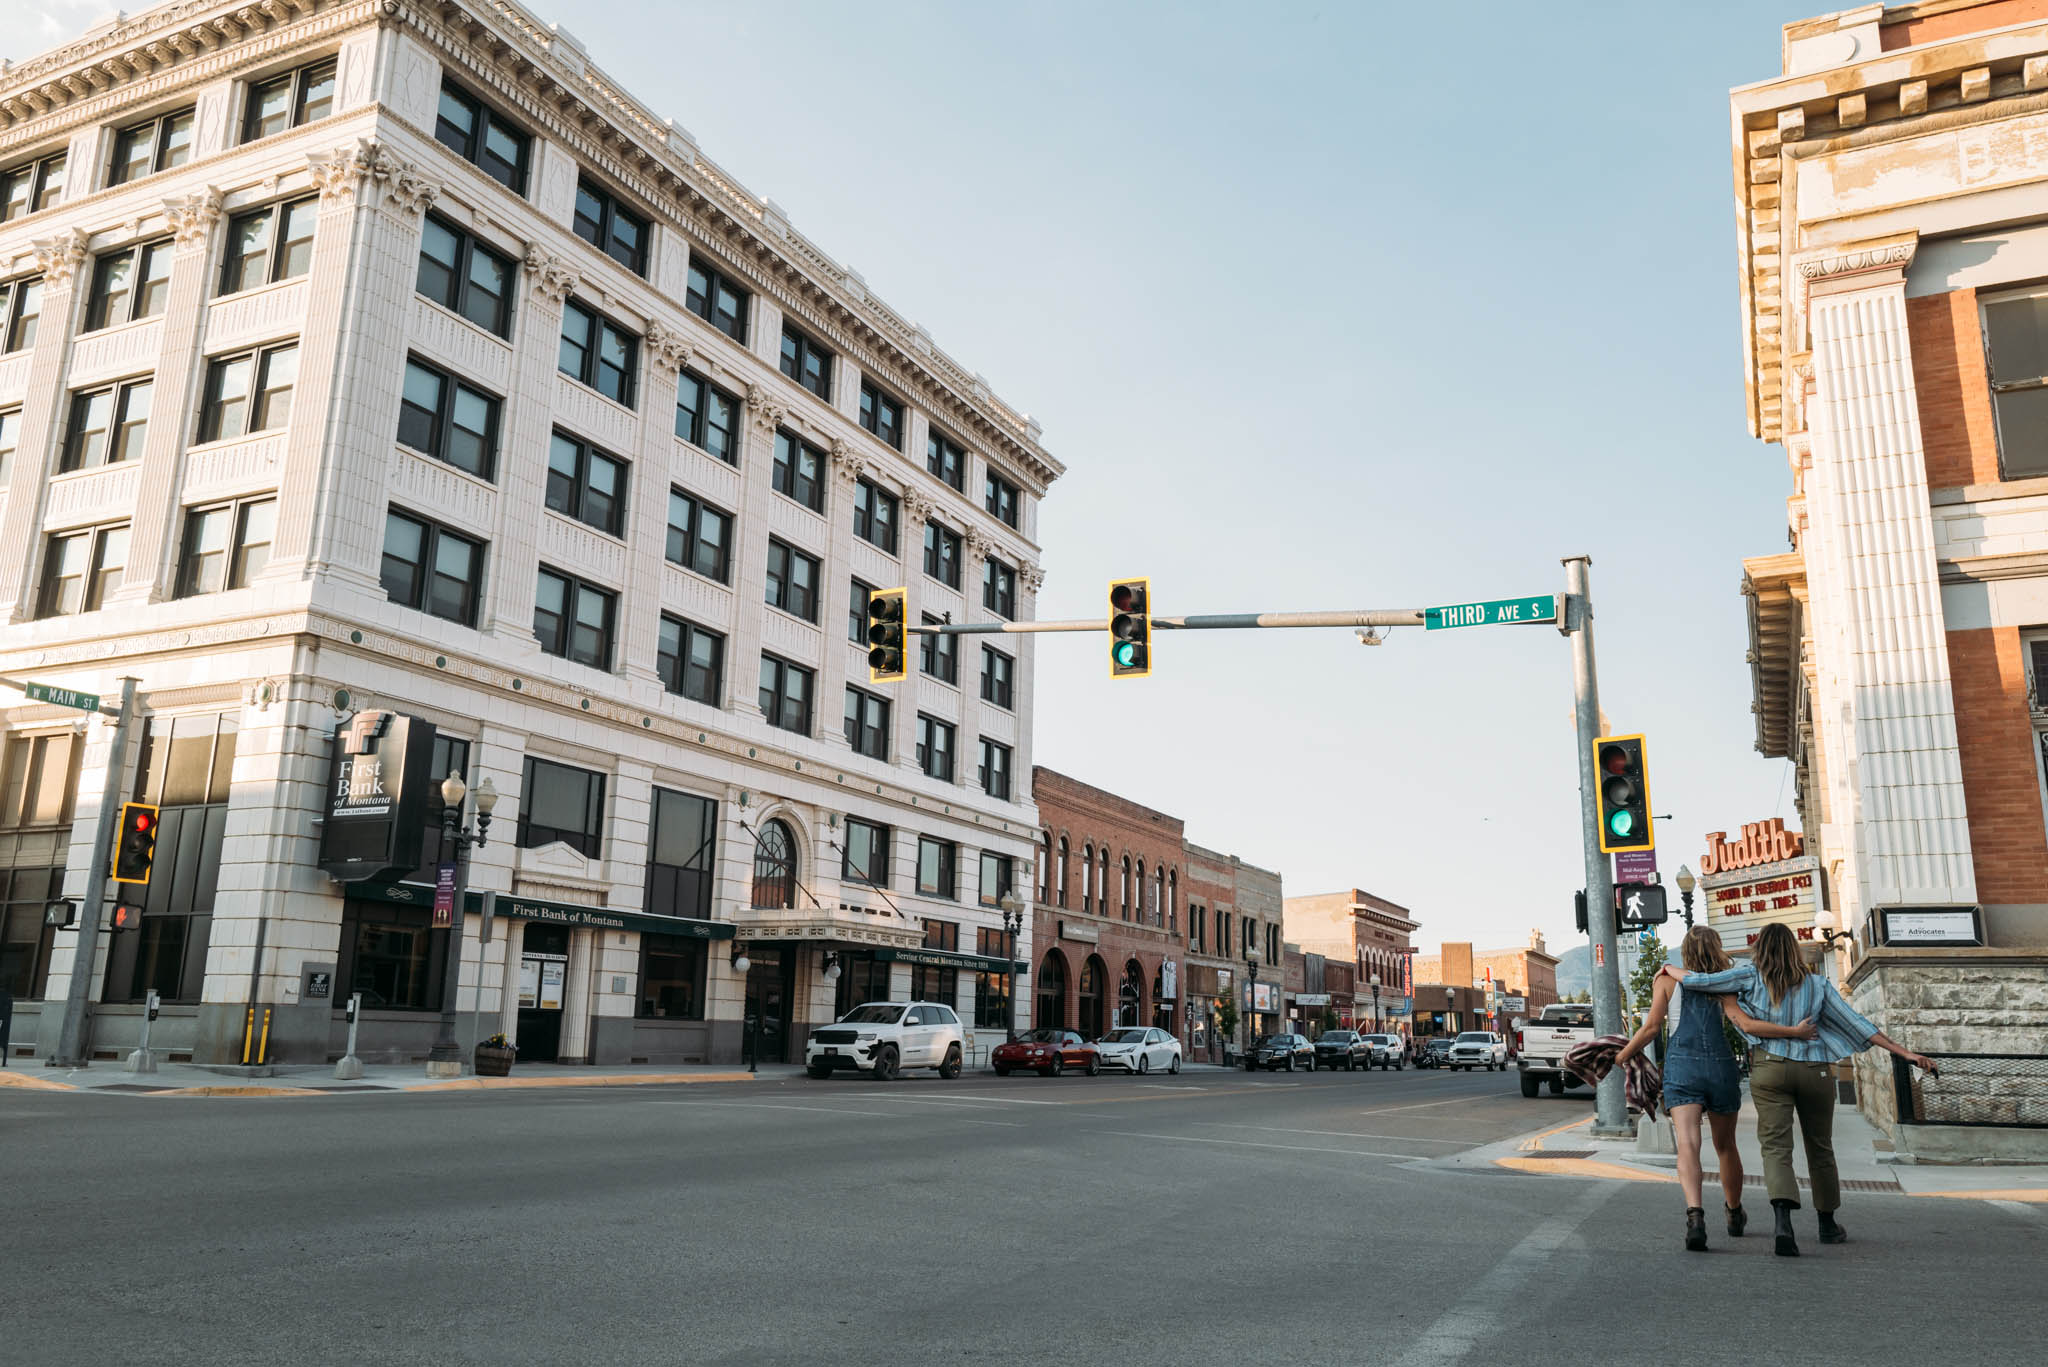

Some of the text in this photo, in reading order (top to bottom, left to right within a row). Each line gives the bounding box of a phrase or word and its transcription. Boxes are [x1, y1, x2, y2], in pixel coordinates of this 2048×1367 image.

[1440, 605, 1485, 626] THIRD
[1498, 605, 1520, 621] AVE
[33, 687, 94, 709] W MAIN ST
[338, 760, 382, 778] First
[336, 777, 385, 797] Bank
[334, 796, 391, 808] of Montana
[1700, 817, 1793, 876] Judith
[1716, 874, 1813, 902] SOUND OF FREEDOM PG13
[512, 904, 624, 927] First Bank of Montana
[1724, 893, 1798, 916] CALL FOR TIMES
[896, 951, 918, 963] Serving
[919, 954, 940, 964] Central
[940, 956, 963, 967] Montana
[1403, 953, 1411, 997] TAVERN
